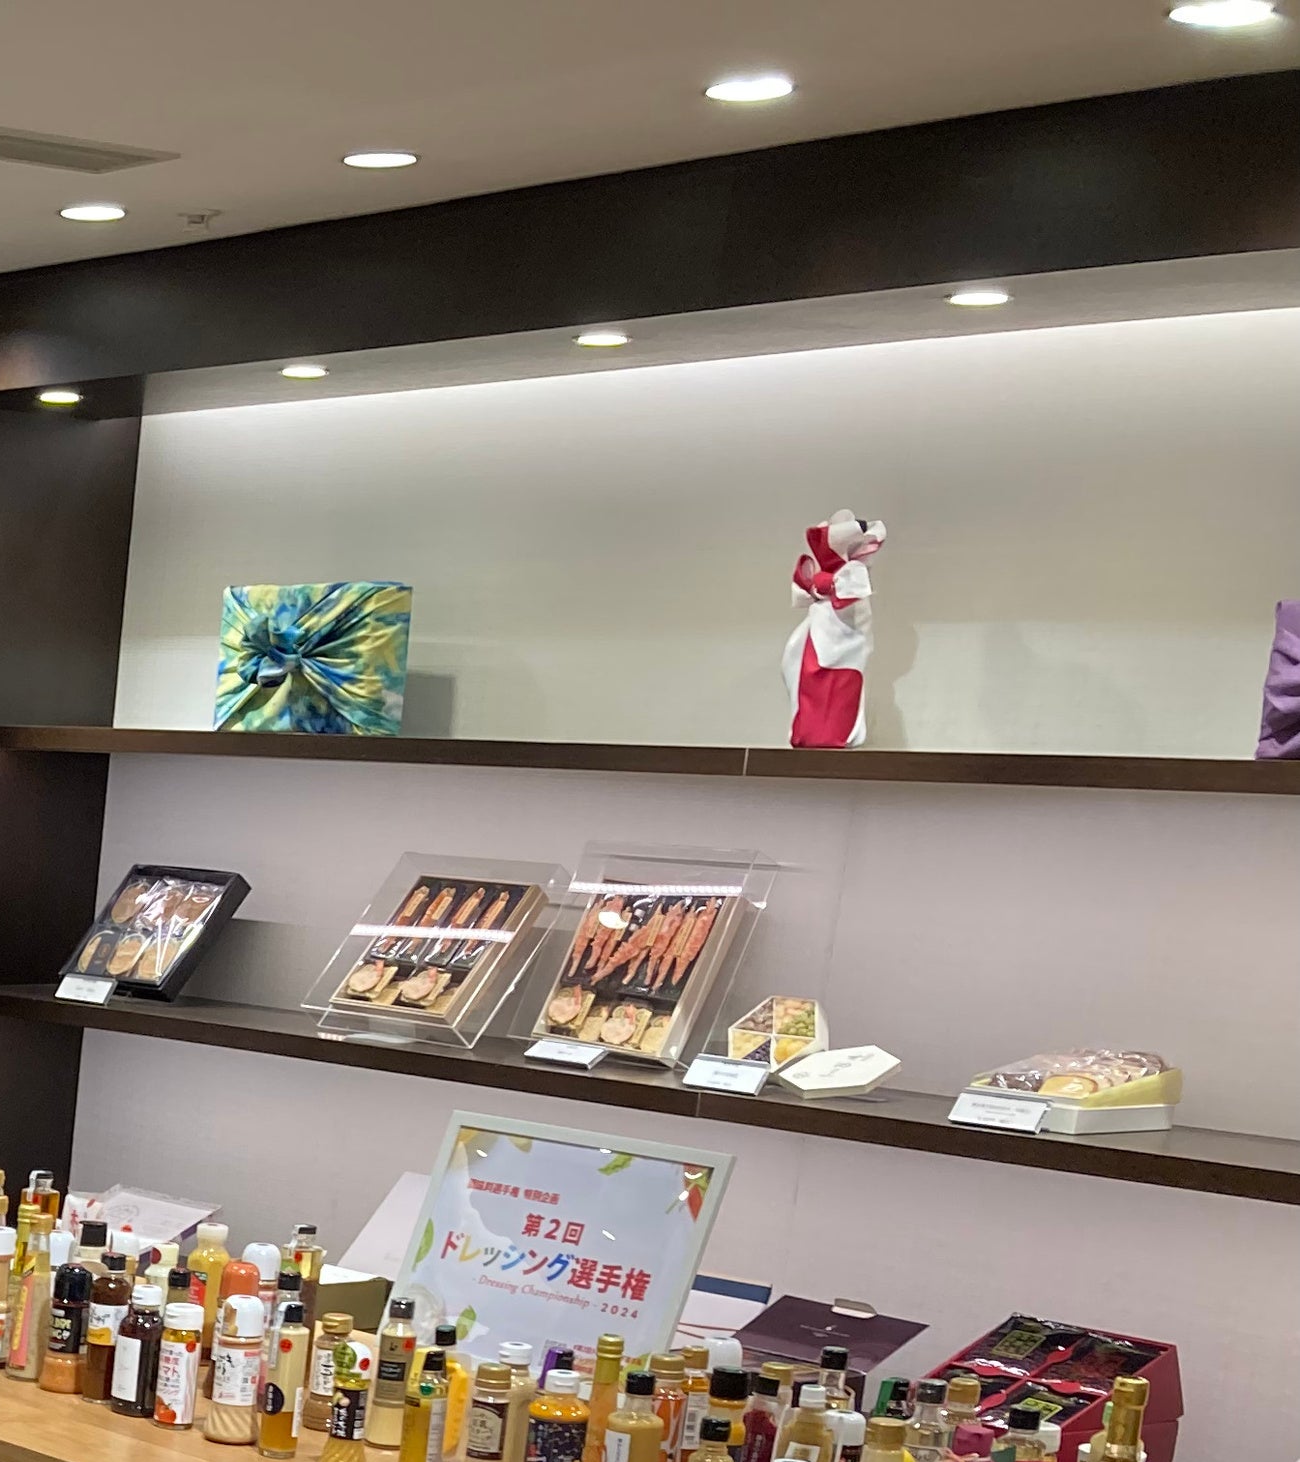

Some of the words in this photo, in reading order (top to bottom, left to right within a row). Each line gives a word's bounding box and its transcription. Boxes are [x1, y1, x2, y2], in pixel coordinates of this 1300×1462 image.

[521, 1212, 586, 1247] 第2回
[440, 1230, 652, 1302] ドレッシング選手権
[478, 1273, 519, 1295] Dressing
[521, 1283, 591, 1310] Championship
[600, 1302, 639, 1319] 2024
